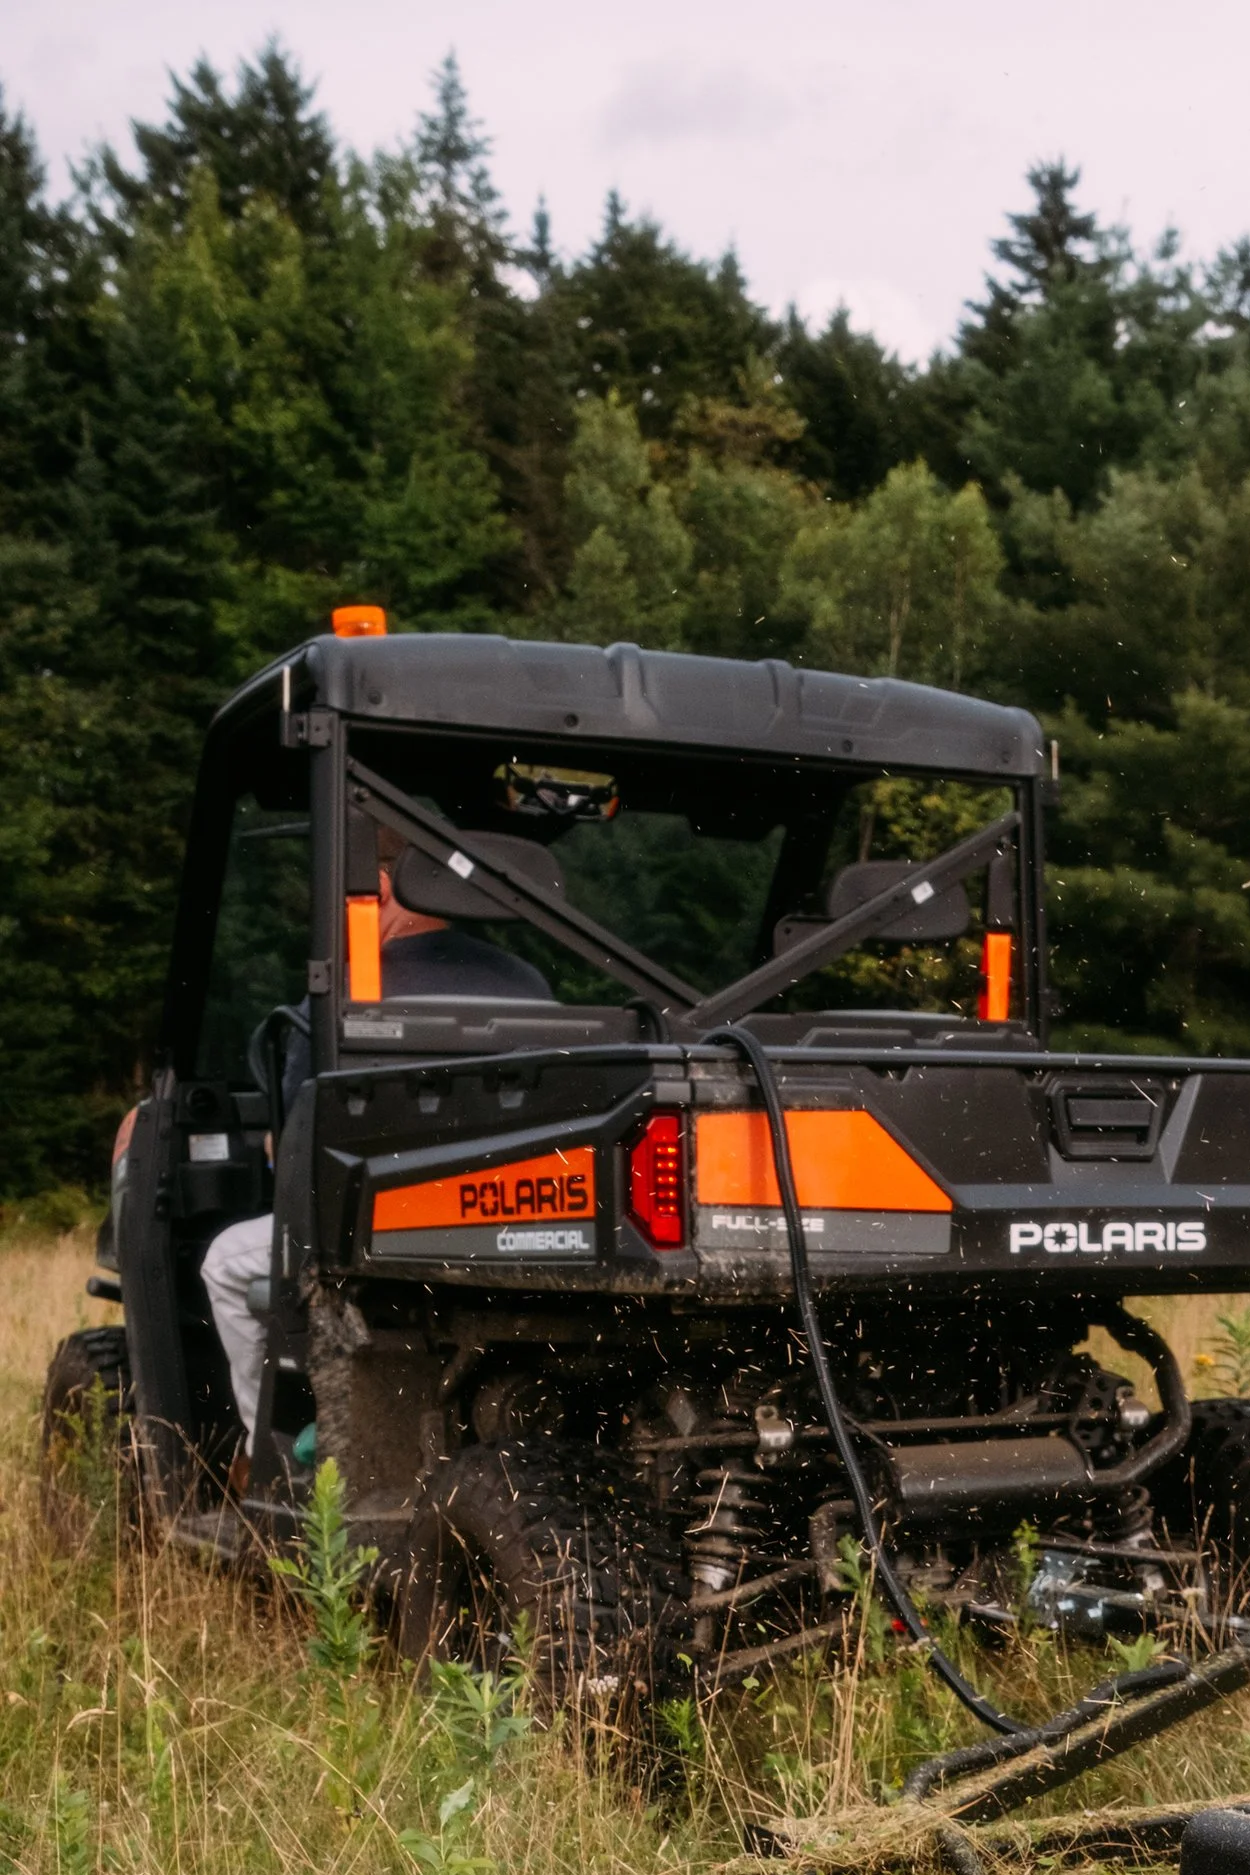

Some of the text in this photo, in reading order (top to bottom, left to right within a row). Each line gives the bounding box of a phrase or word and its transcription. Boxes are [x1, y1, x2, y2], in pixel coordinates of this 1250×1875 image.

[460, 1174, 588, 1218] POLARIS
[712, 1215, 824, 1232] FULL-SZE
[497, 1230, 590, 1251] COMMERCIAL
[1010, 1222, 1207, 1253] POLARIS
